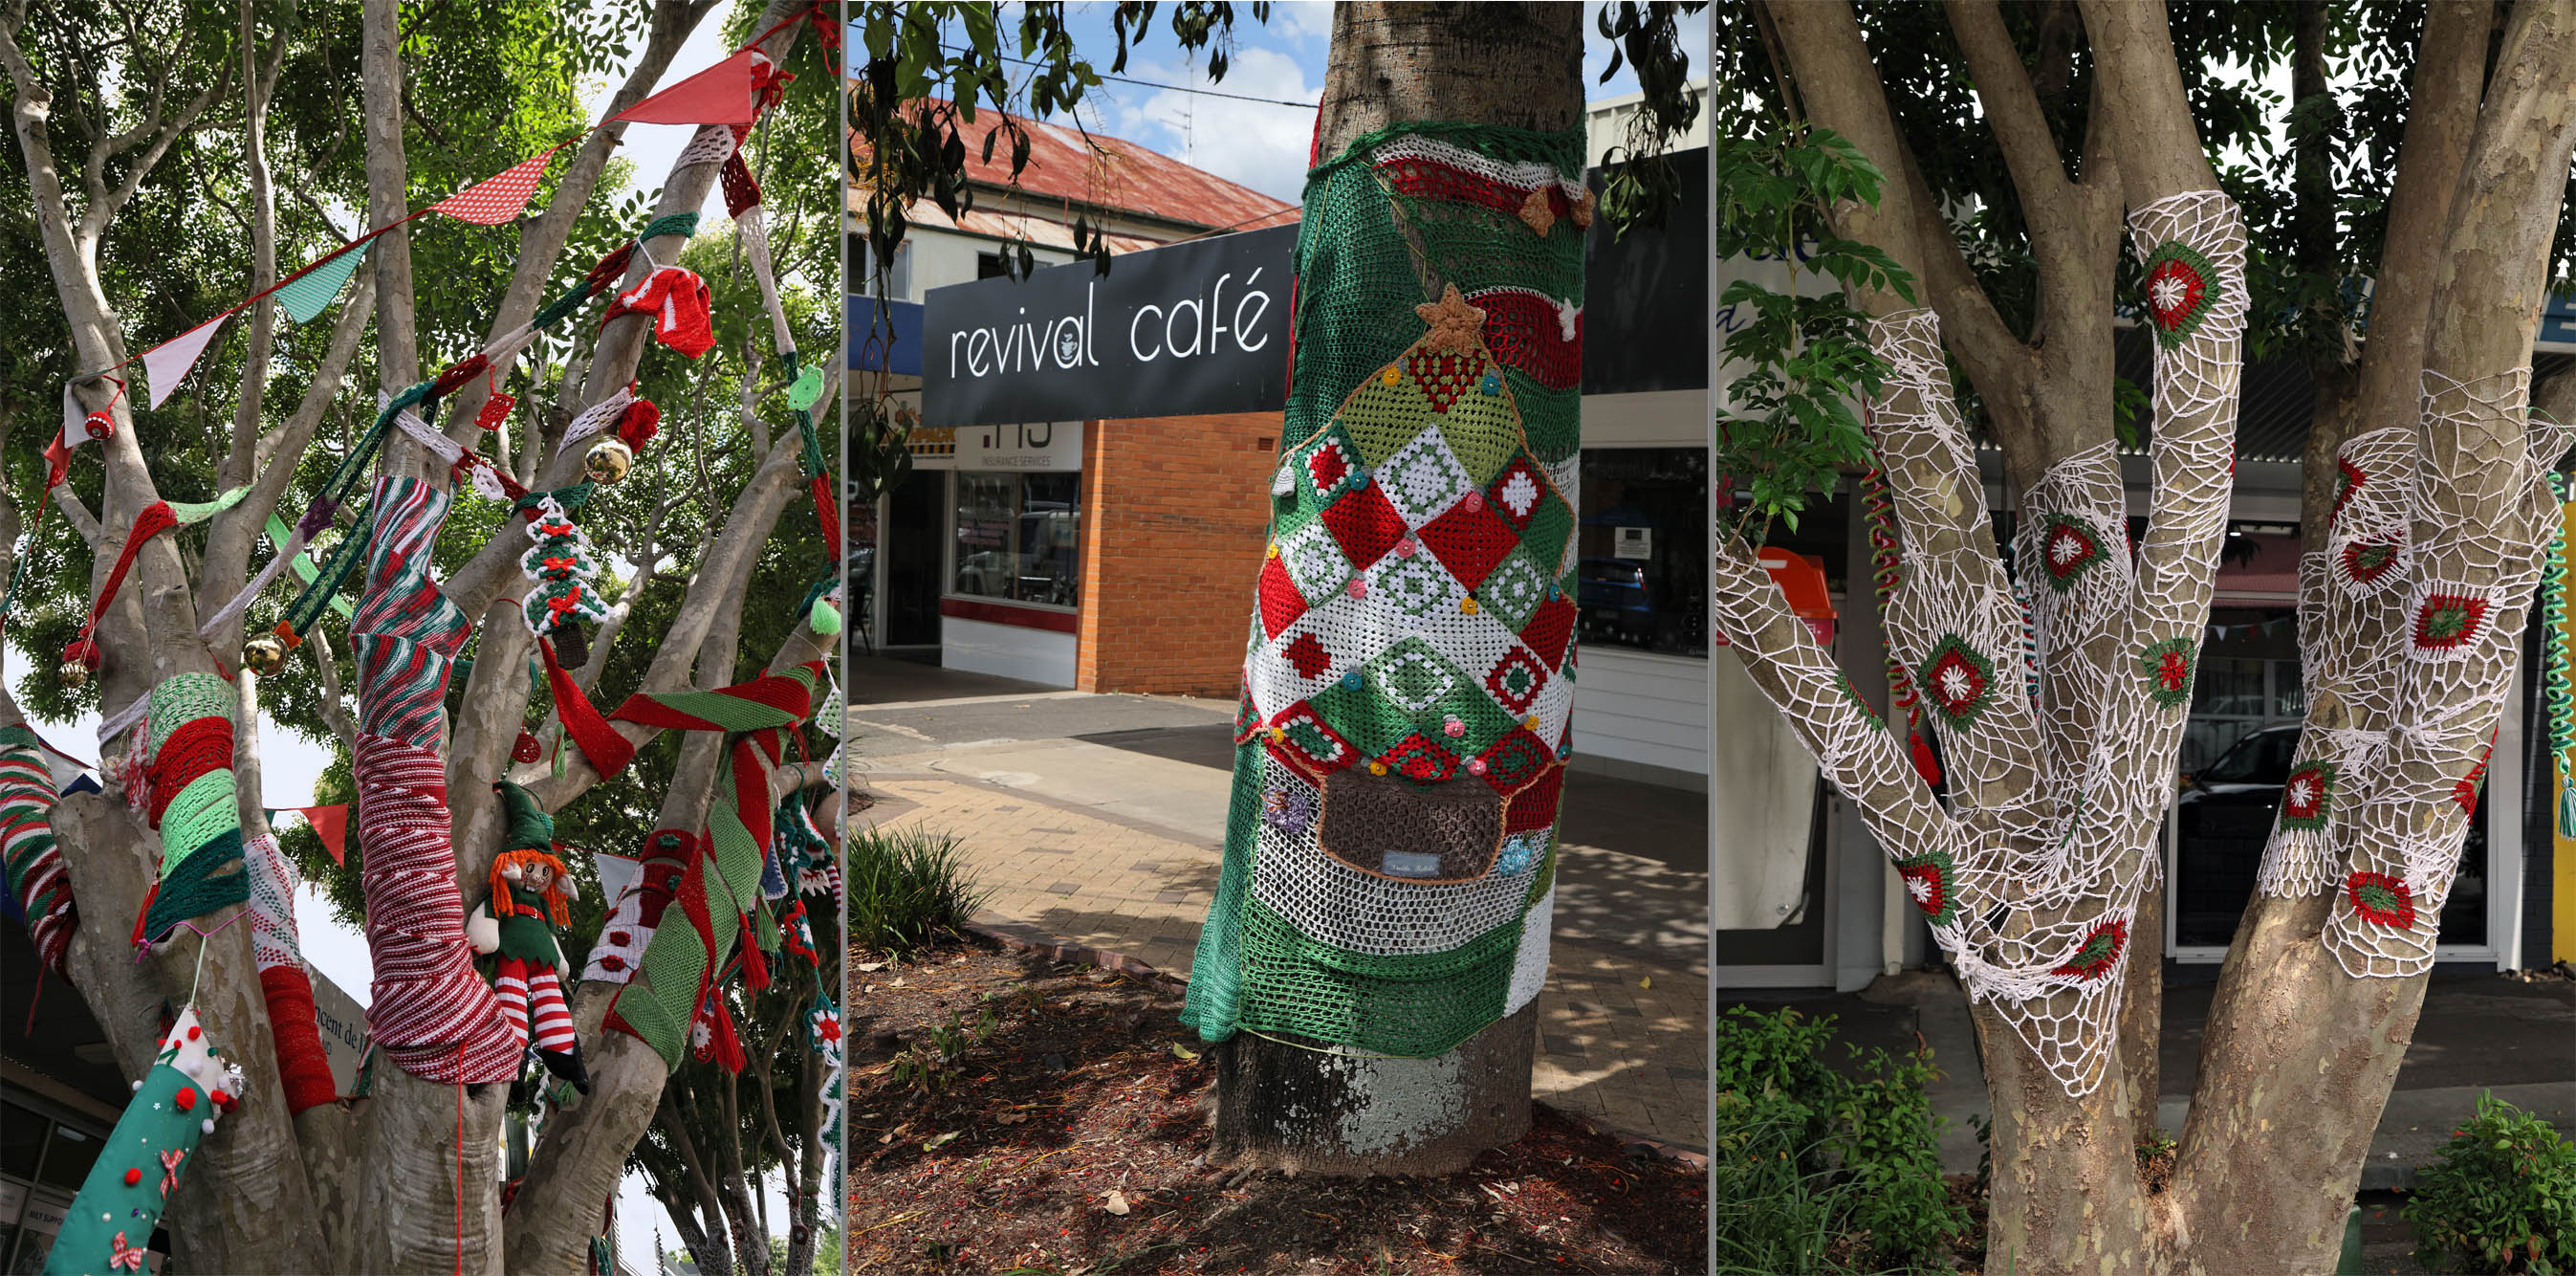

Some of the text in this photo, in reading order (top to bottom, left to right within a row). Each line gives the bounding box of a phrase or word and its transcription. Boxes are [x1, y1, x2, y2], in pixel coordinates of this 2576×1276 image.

[950, 267, 1271, 379] revival café
[982, 455, 1051, 467] INSURANCE SERVICES
[345, 1023, 358, 1049] de
